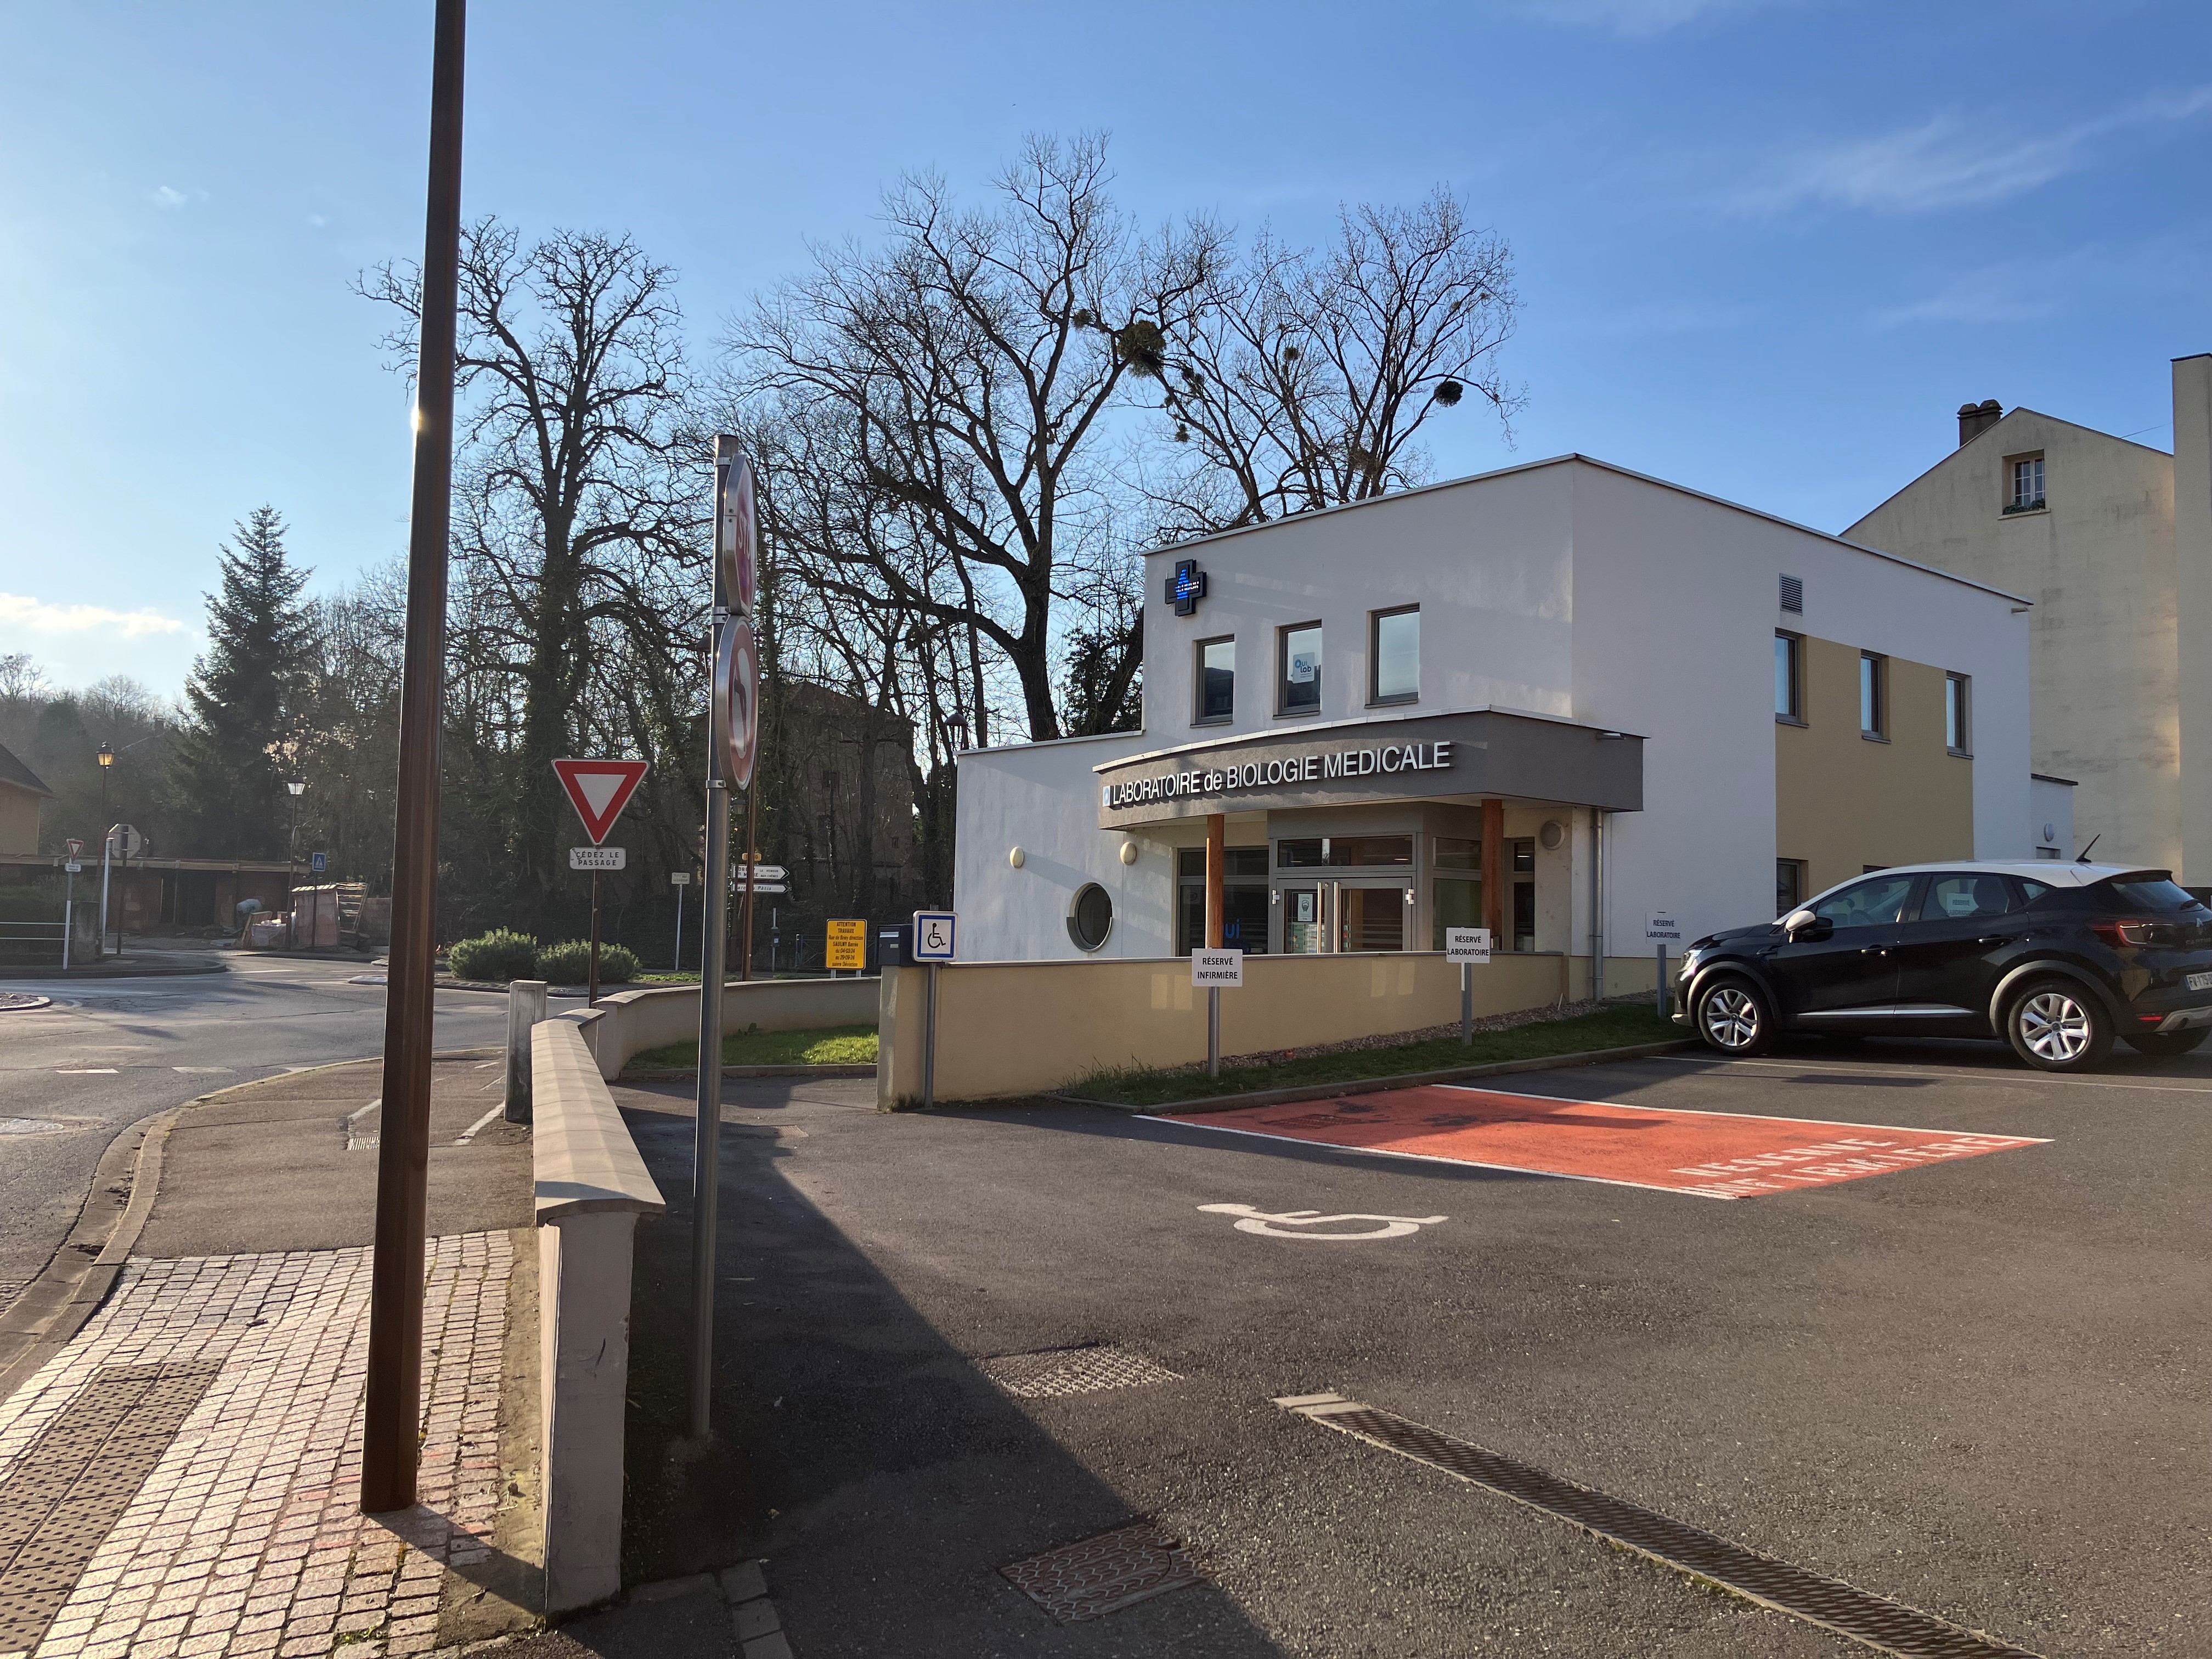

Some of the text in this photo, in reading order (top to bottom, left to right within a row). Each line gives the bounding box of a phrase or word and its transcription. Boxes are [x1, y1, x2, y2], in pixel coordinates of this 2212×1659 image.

[1112, 741, 1451, 805] LABORATOIRE de BIOLOGIE MEDICALE
[1653, 918, 1675, 927] RÉSERVÉ
[1455, 934, 1481, 943] RÉSERVÉ
[1646, 931, 1681, 939] LABORATOIRE
[1447, 948, 1489, 956] LABORATOIRE
[1202, 956, 1233, 966] RÉSERVÉ
[1197, 970, 1238, 979] INFIRMIÈRE
